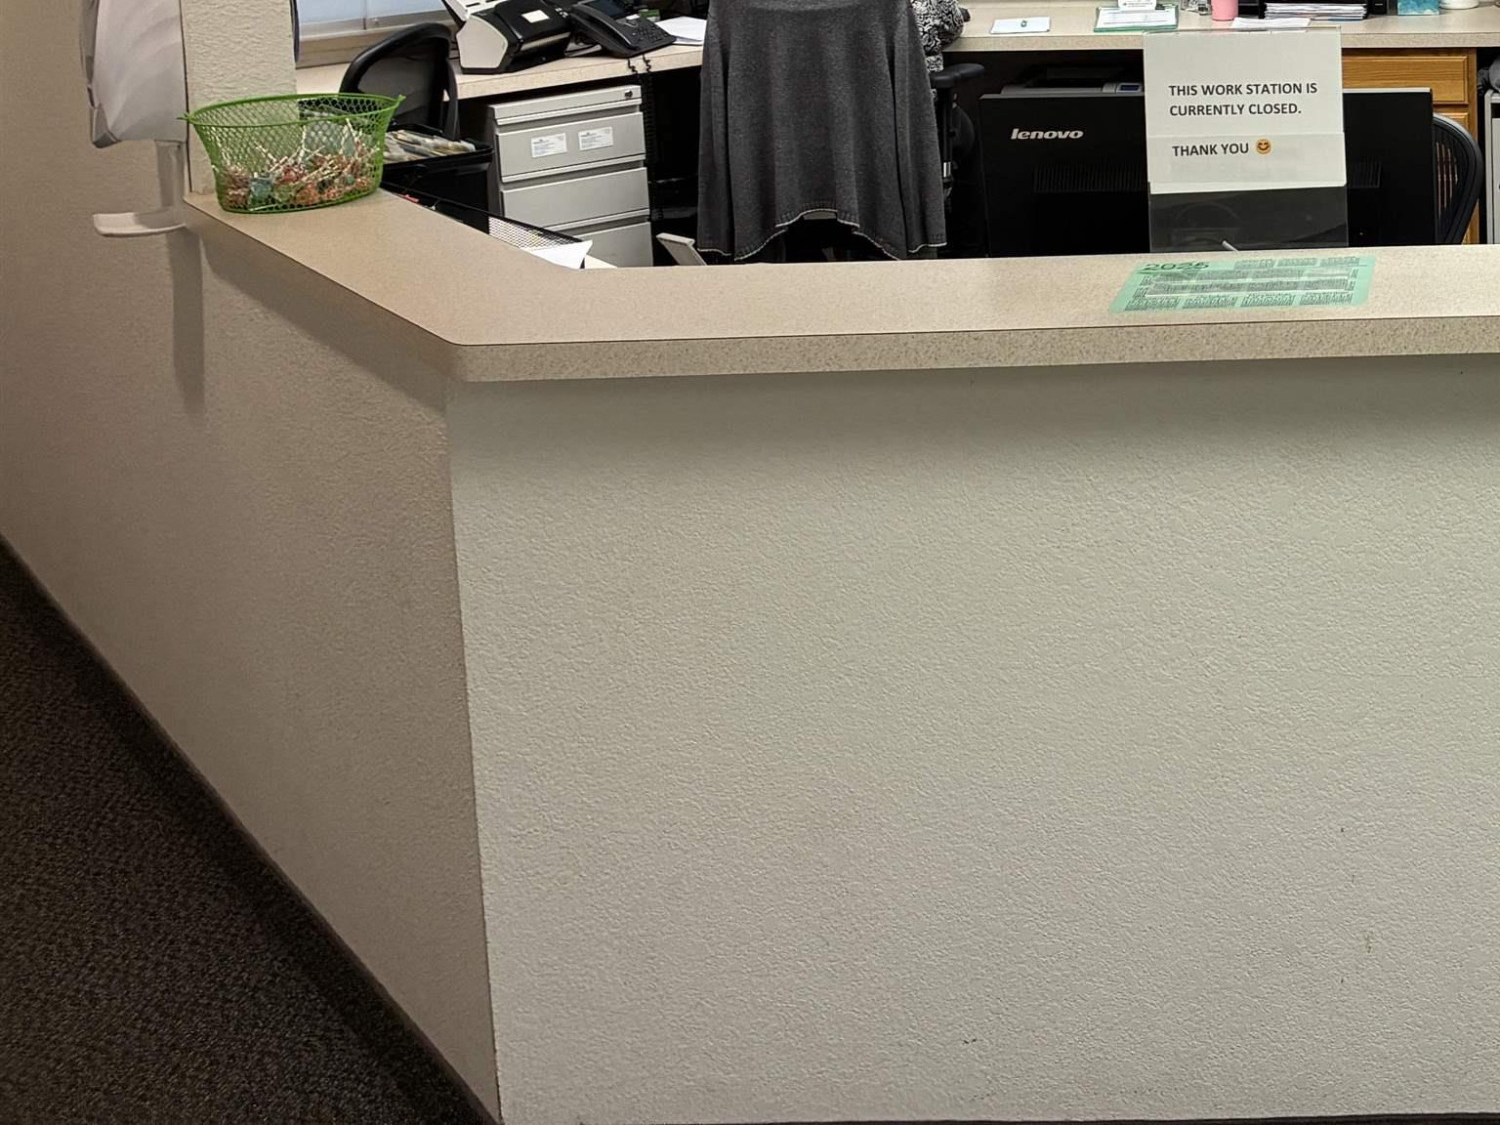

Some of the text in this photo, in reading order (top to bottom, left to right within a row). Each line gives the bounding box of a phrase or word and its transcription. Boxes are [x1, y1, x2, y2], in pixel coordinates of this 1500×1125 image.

[1168, 82, 1318, 96] THIS WORK STATION IS
[1169, 103, 1302, 116] CURRENTLY CLOSED.
[1011, 128, 1084, 140] lenovo
[1172, 143, 1249, 157] THANK YOU
